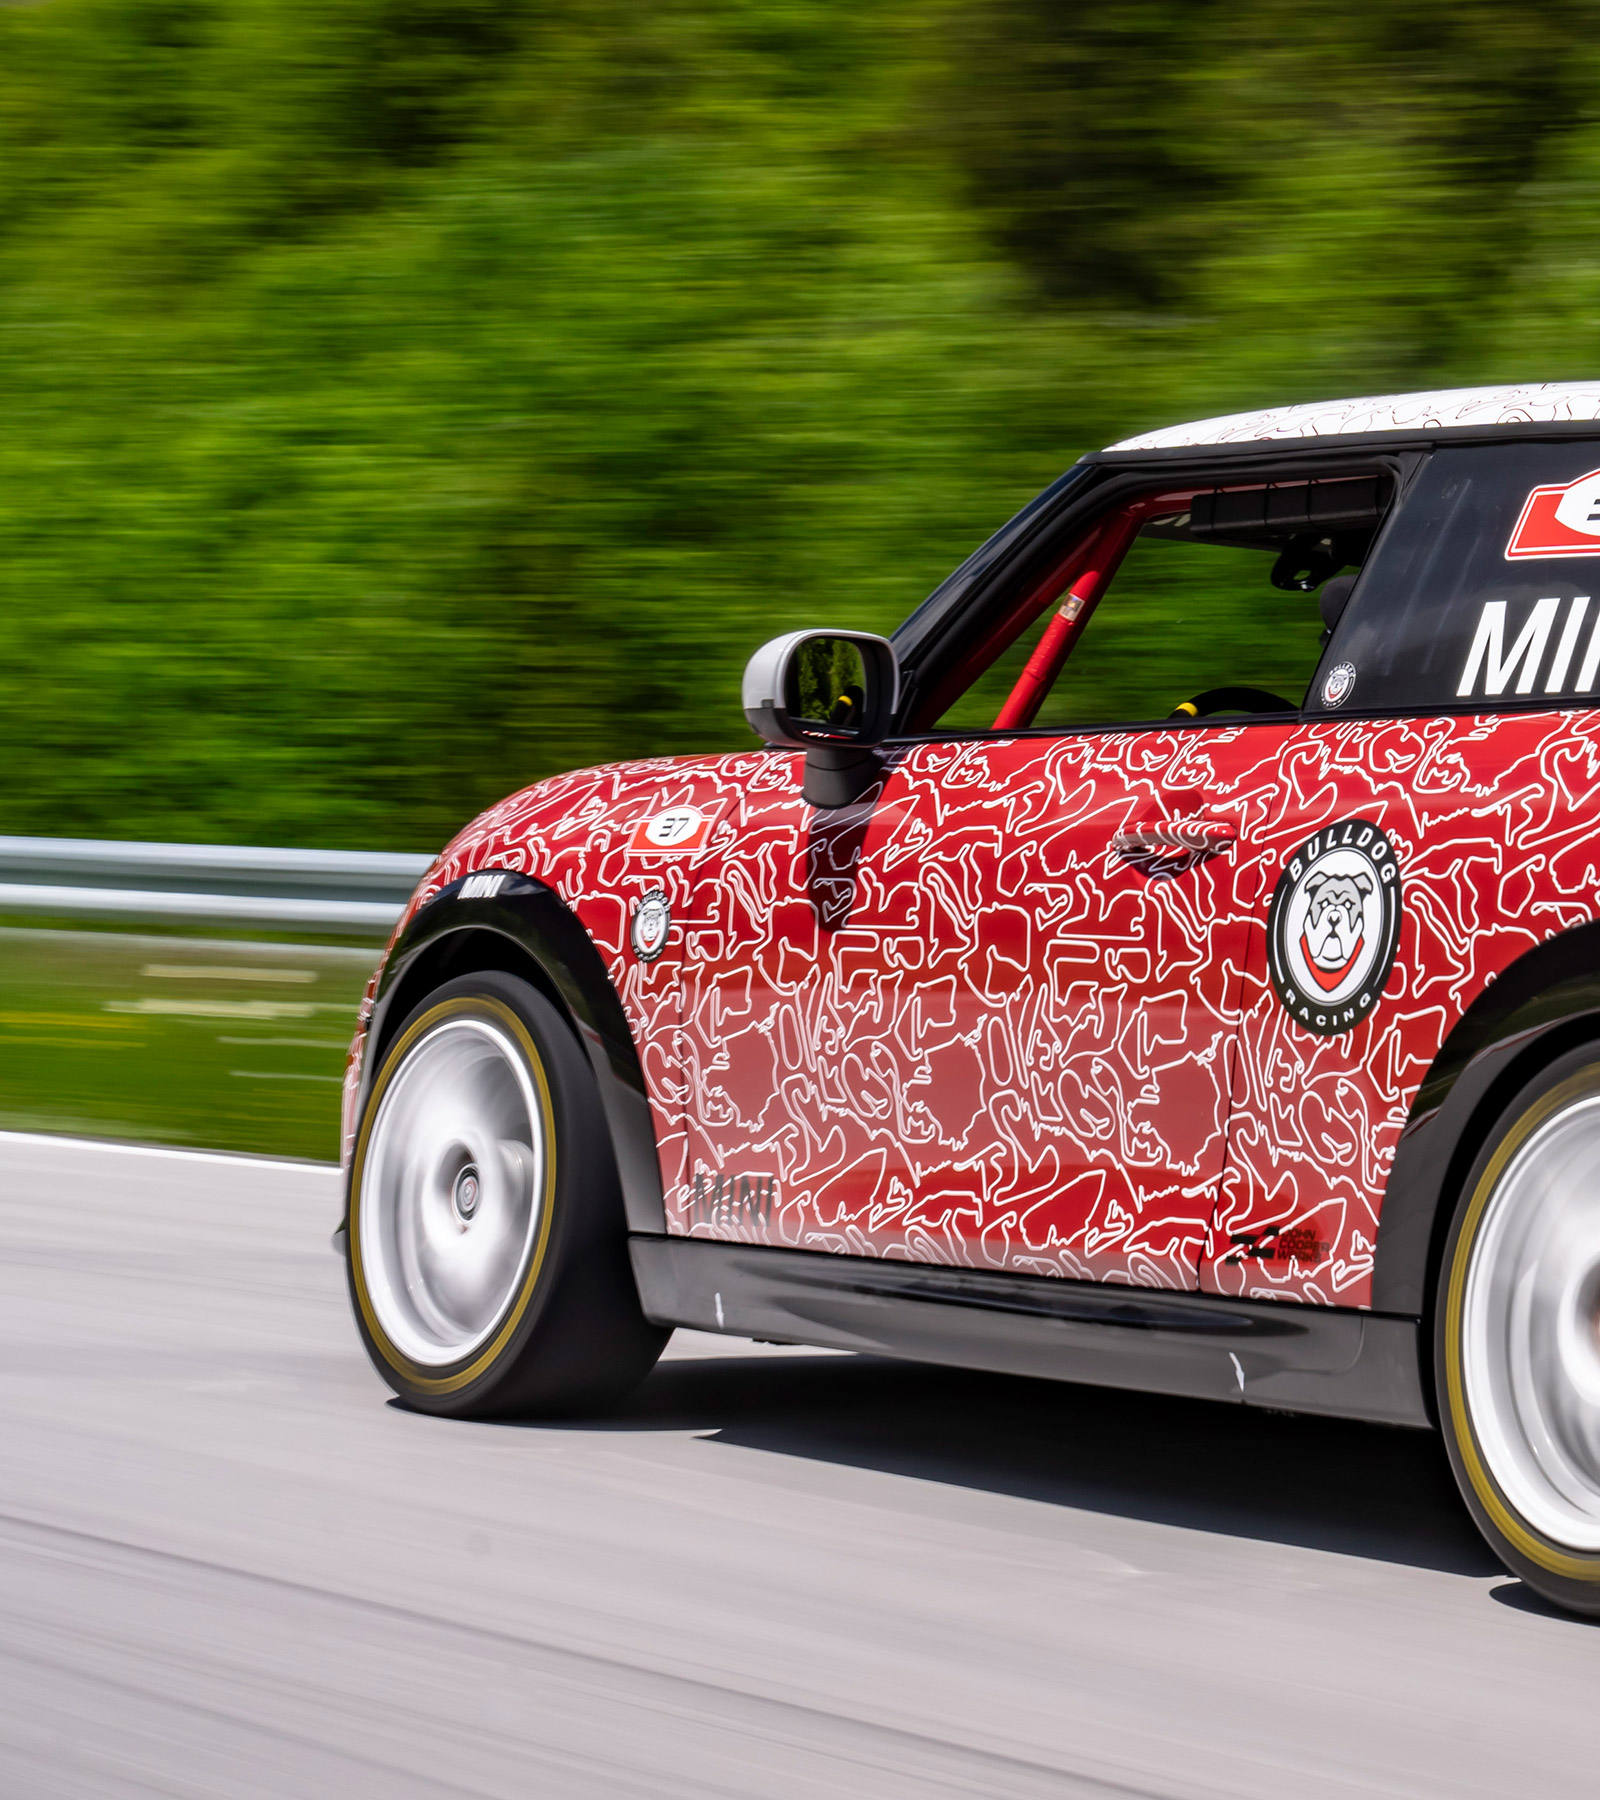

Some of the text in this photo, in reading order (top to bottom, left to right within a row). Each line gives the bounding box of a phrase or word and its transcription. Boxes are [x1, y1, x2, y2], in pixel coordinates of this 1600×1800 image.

[659, 817, 690, 837] 37
[1289, 824, 1396, 884] BULLDOG
[457, 874, 506, 900] MINI
[1286, 989, 1371, 1027] RACING
[695, 1173, 773, 1227] MINI
[1277, 1249, 1322, 1263] WORKS
[1279, 1239, 1331, 1253] COOPER
